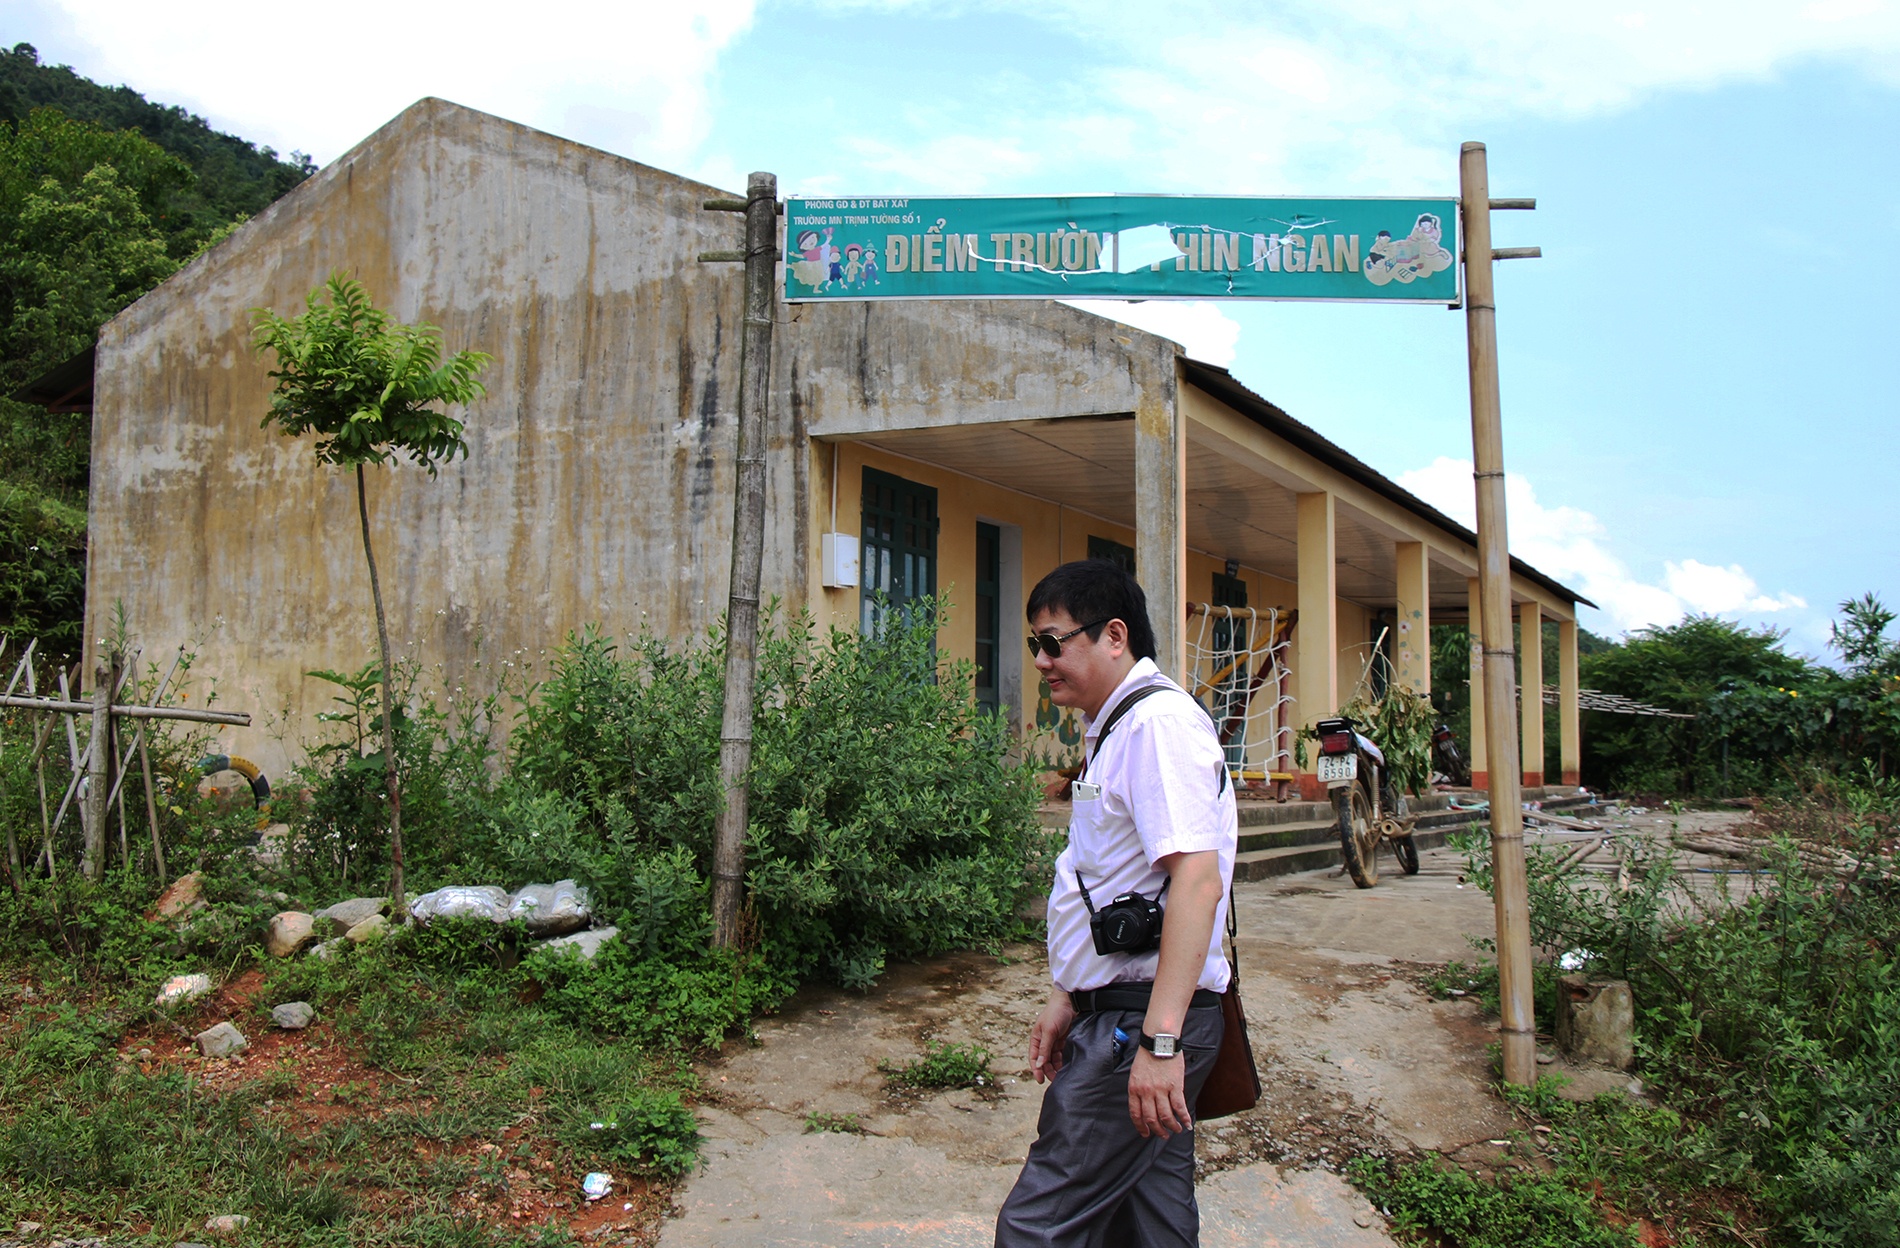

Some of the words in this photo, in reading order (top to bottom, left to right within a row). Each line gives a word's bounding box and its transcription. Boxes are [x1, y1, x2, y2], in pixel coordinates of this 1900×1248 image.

[850, 200, 858, 209] &
[828, 215, 842, 225] MN
[902, 211, 914, 224] SỐ
[916, 215, 921, 224] 1
[885, 217, 979, 273] ĐIỂM
[1253, 233, 1360, 273] NGAN
[1324, 767, 1351, 779] 8590
